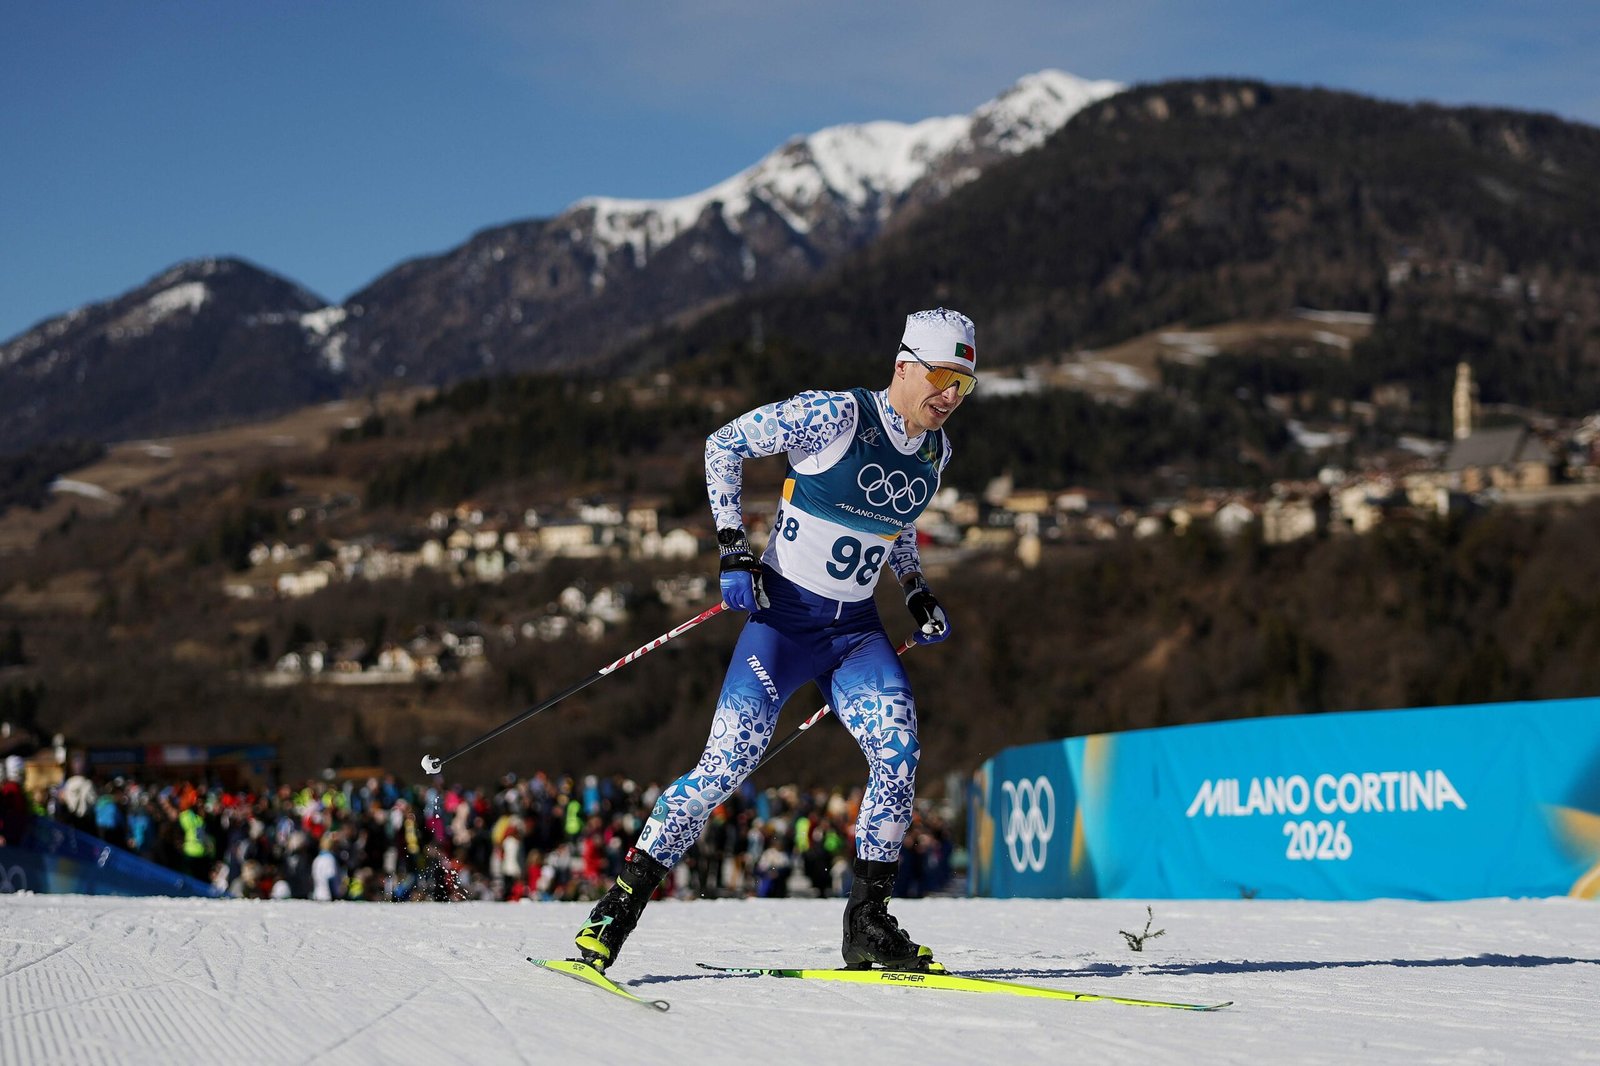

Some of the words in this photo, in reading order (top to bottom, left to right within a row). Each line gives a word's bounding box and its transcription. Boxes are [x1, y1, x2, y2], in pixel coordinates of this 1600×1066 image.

[835, 503, 874, 518] MILANO
[873, 513, 906, 528] CORTINA
[826, 535, 886, 586] 98
[746, 654, 780, 703] TRIMTEX
[1186, 774, 1311, 817] MILANO
[1313, 769, 1468, 814] CORTINA
[1283, 820, 1353, 860] 2026
[880, 972, 926, 983] FISCHER
